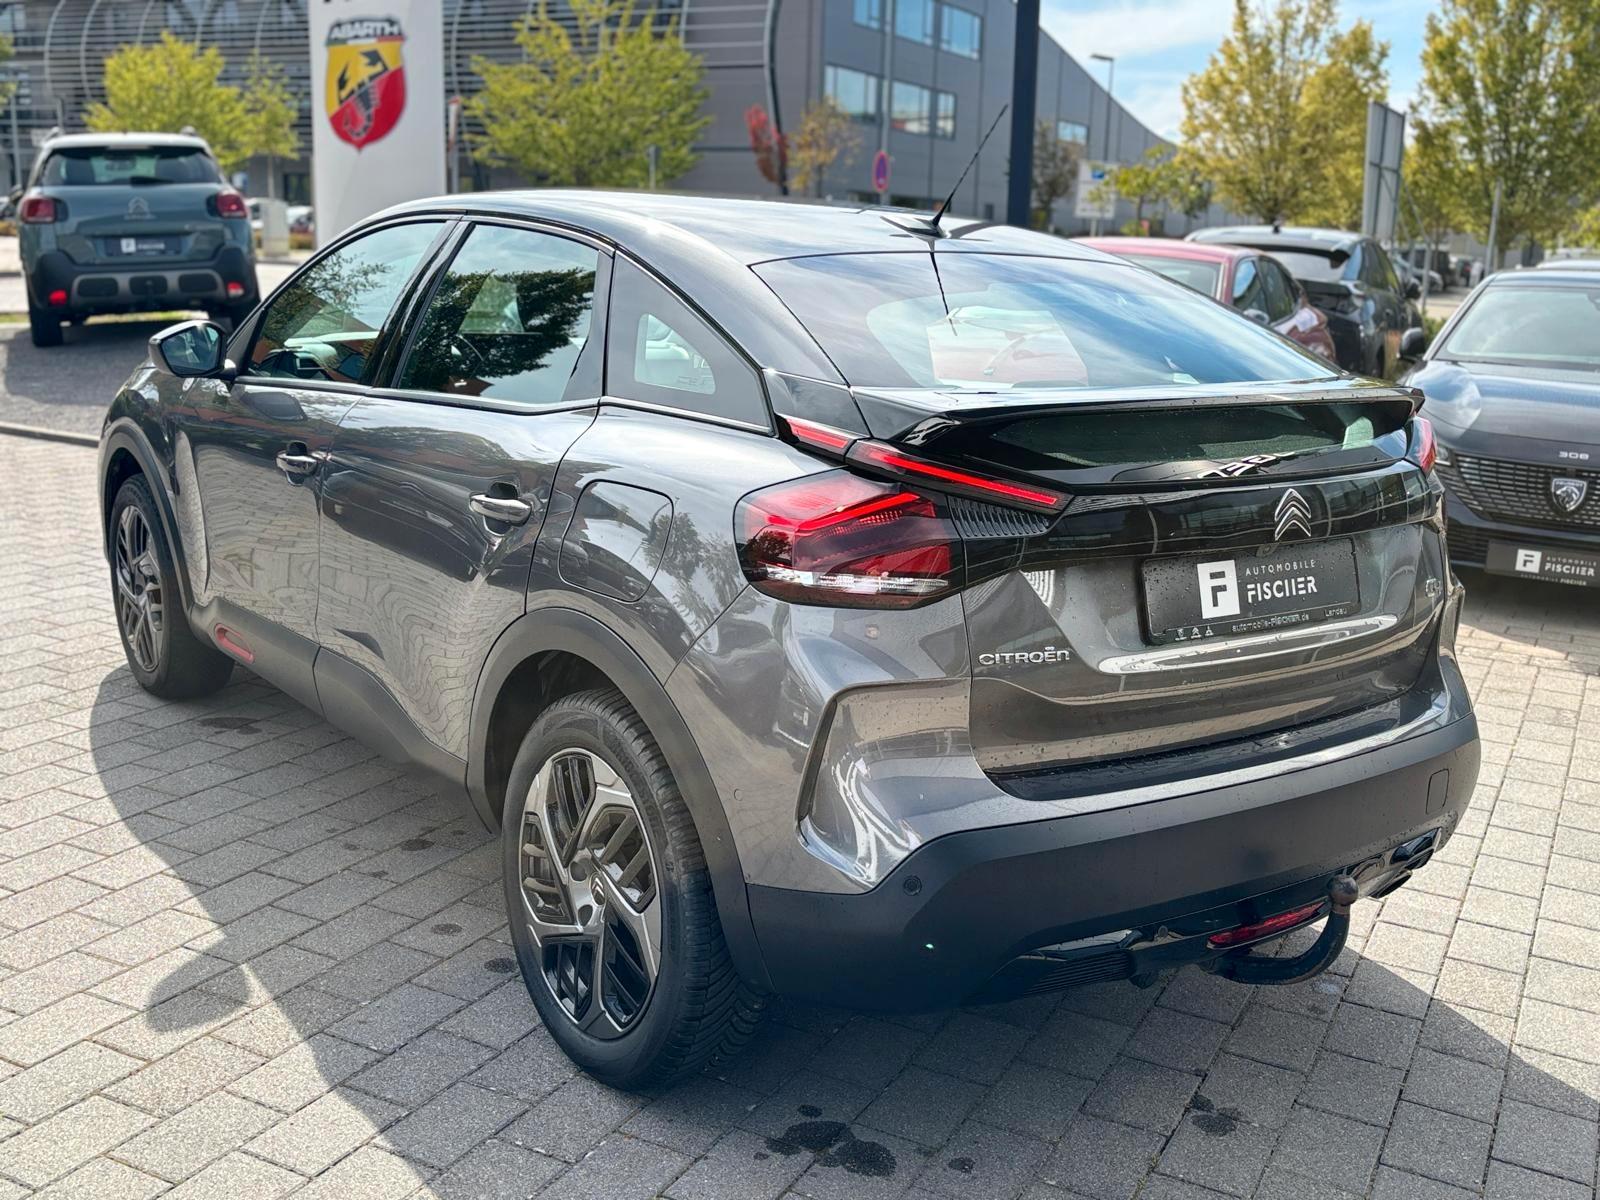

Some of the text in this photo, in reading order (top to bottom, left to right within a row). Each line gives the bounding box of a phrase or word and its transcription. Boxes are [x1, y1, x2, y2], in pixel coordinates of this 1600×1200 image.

[329, 21, 399, 39] ABARTH
[1558, 450, 1590, 460] 308
[1245, 559, 1317, 576] AUTOMOBILE
[1546, 556, 1597, 567] AUTOMOBILE
